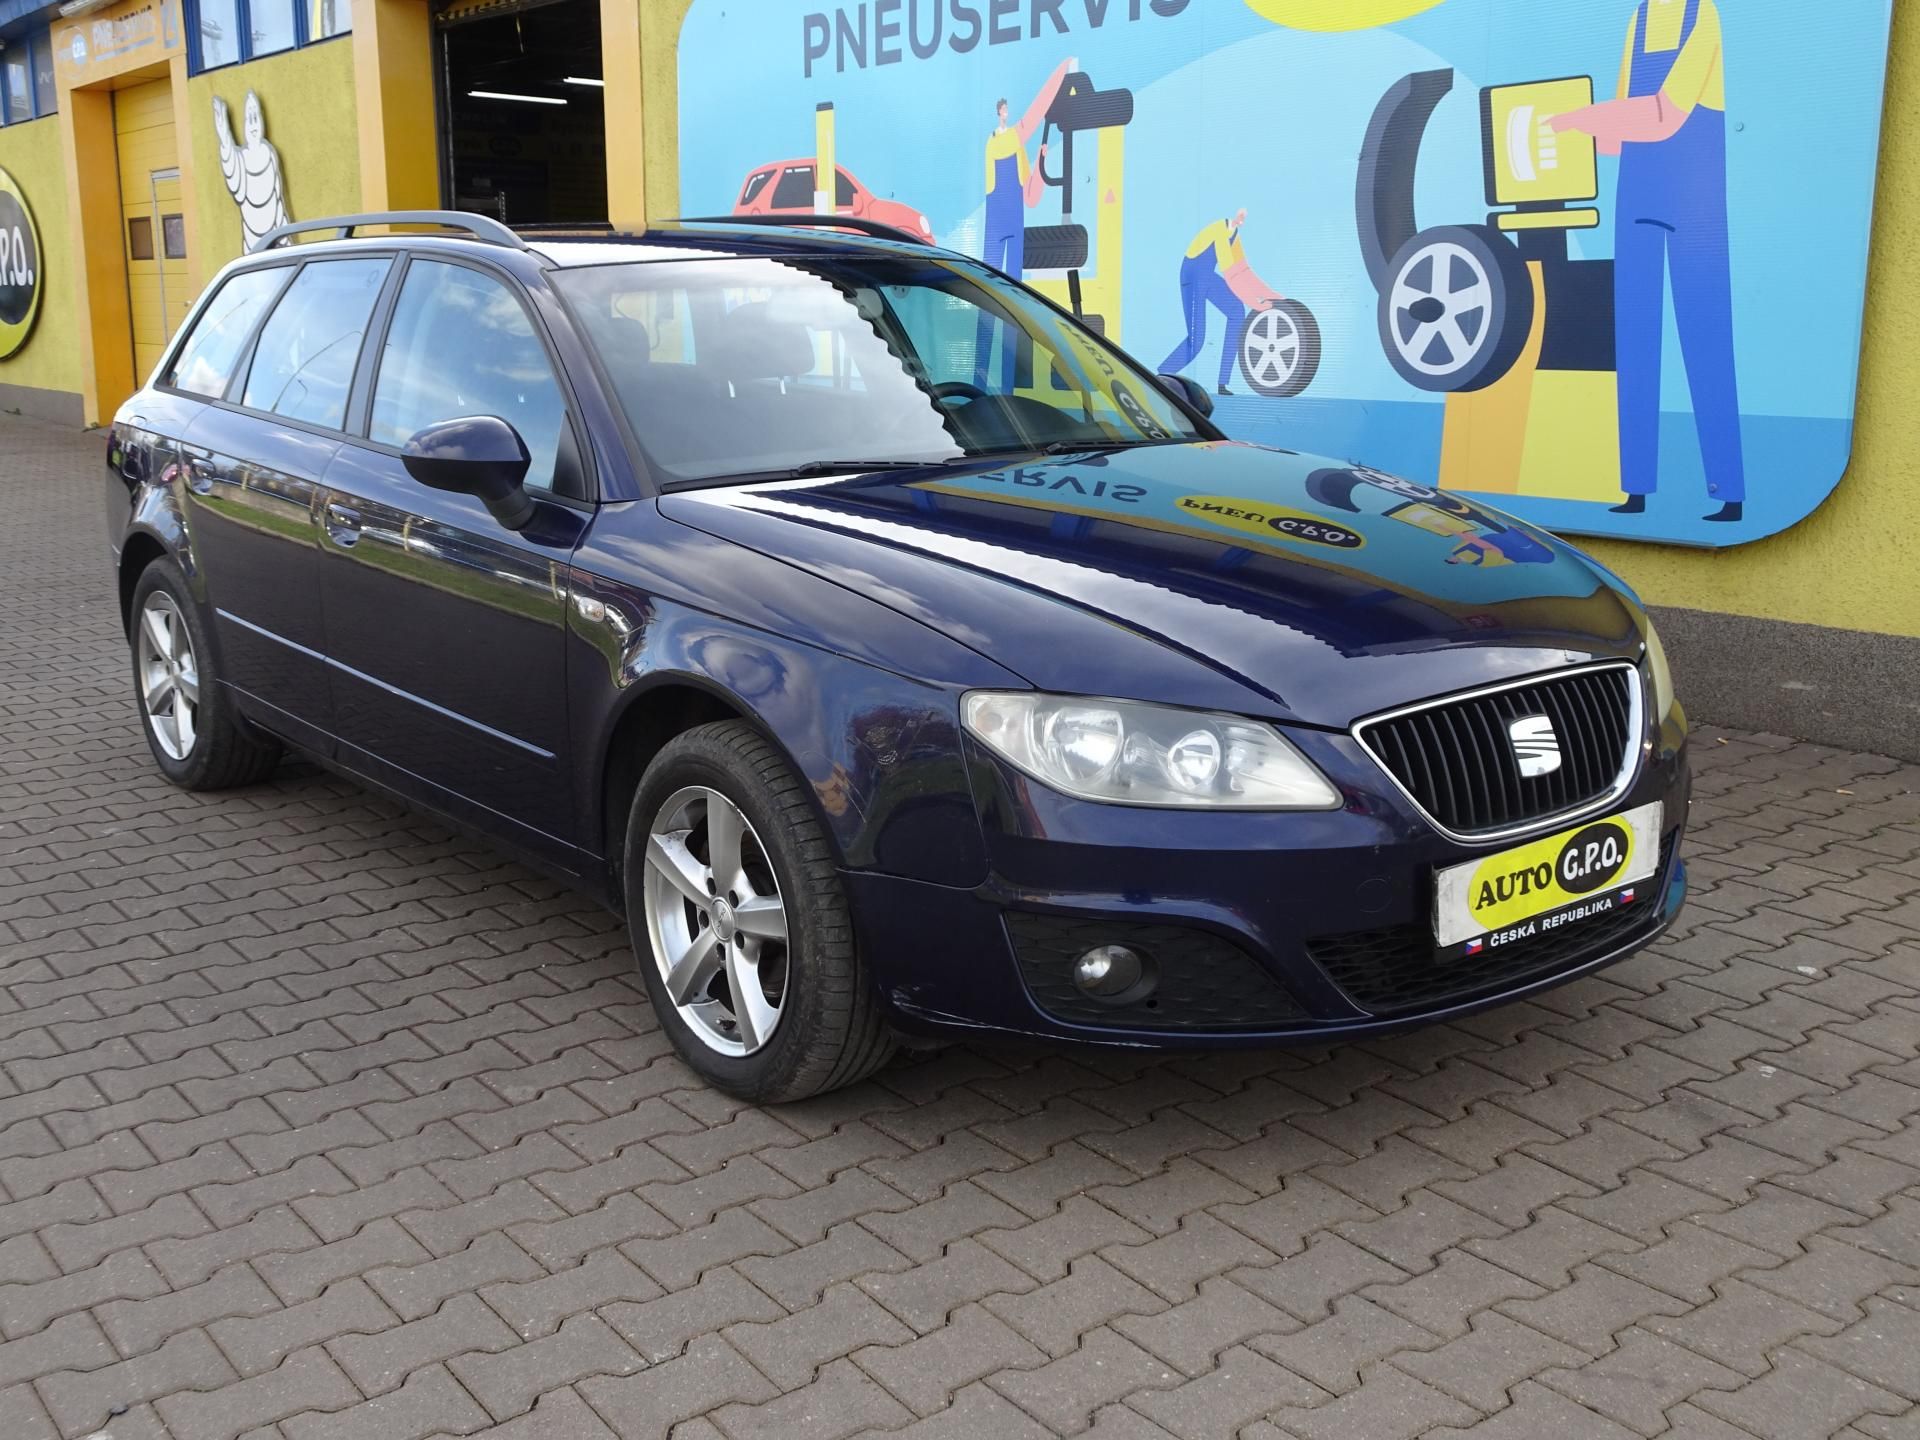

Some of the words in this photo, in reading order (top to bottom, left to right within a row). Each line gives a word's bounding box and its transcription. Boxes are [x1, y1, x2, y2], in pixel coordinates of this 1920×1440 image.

[803, 0, 1191, 78] PNEUSER
[0, 226, 34, 286] P.O.
[1475, 862, 1552, 910] AUTO
[1563, 837, 1623, 881] G.P.O.
[1490, 922, 1535, 947] ČESKÁ
[1542, 898, 1612, 931] REPUBLIKA
